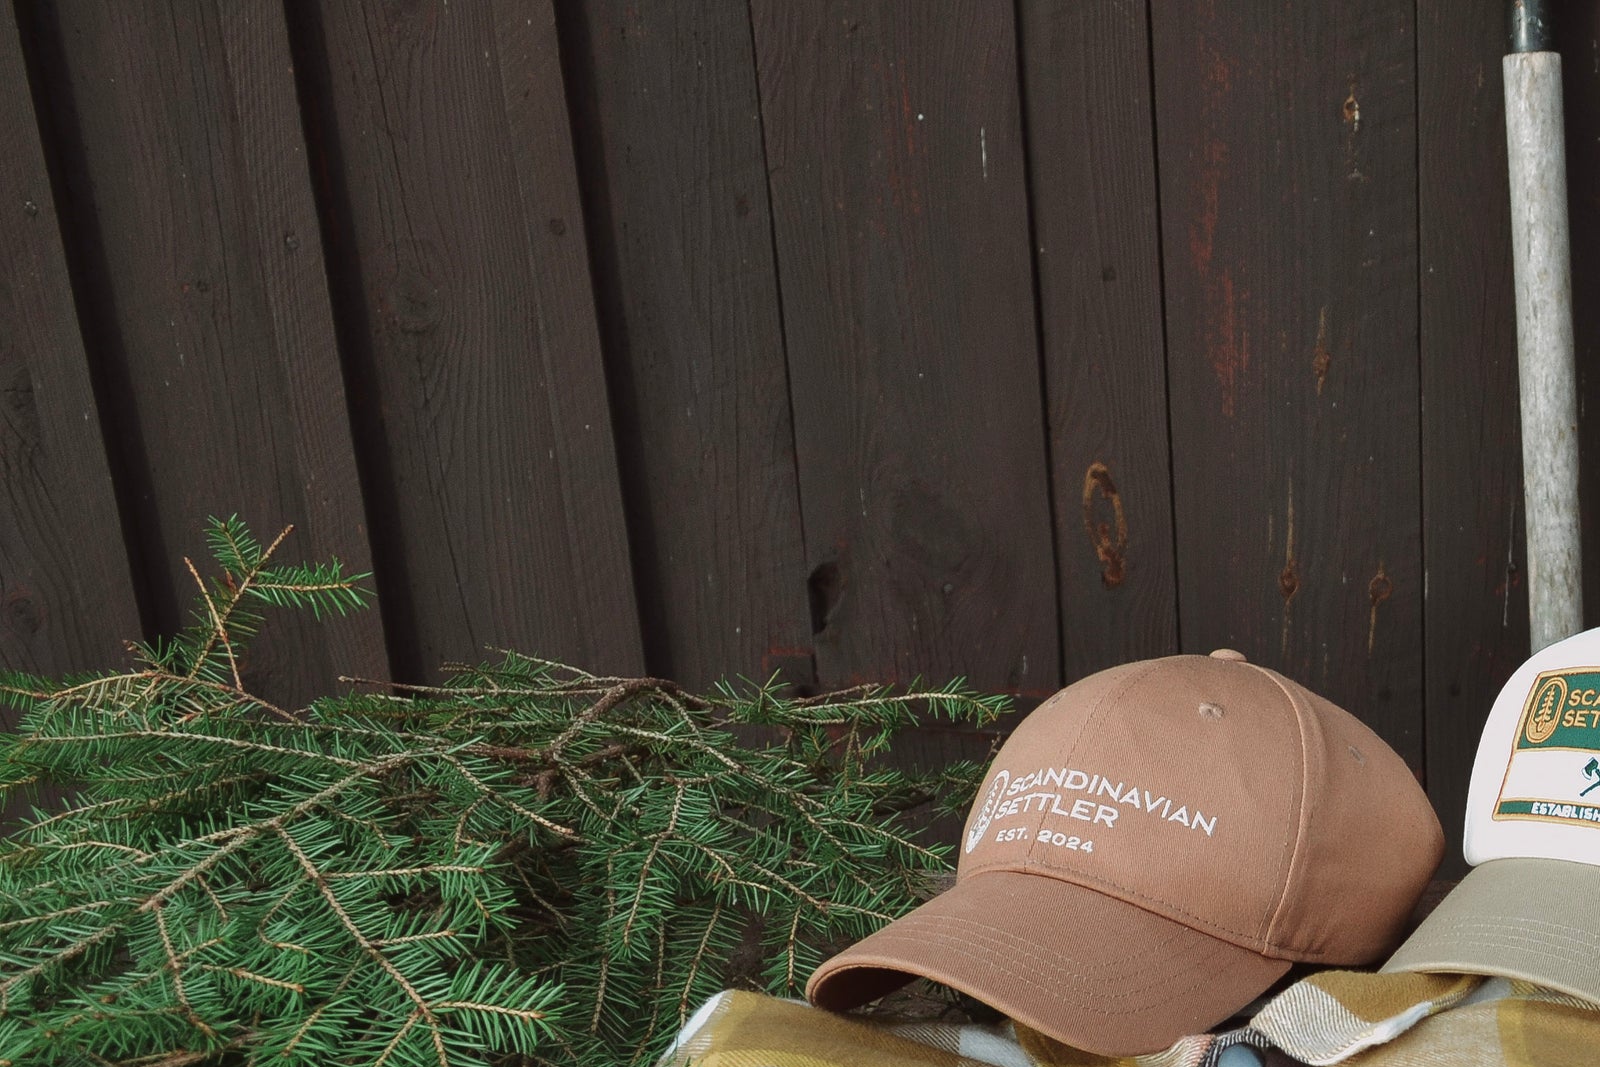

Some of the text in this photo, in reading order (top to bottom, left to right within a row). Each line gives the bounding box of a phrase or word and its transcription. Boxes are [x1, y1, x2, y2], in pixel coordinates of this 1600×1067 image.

[994, 792, 1120, 828] SETTLER
[1006, 767, 1217, 837] SCANDINAVIAN
[994, 827, 1094, 854] EST. 2024
